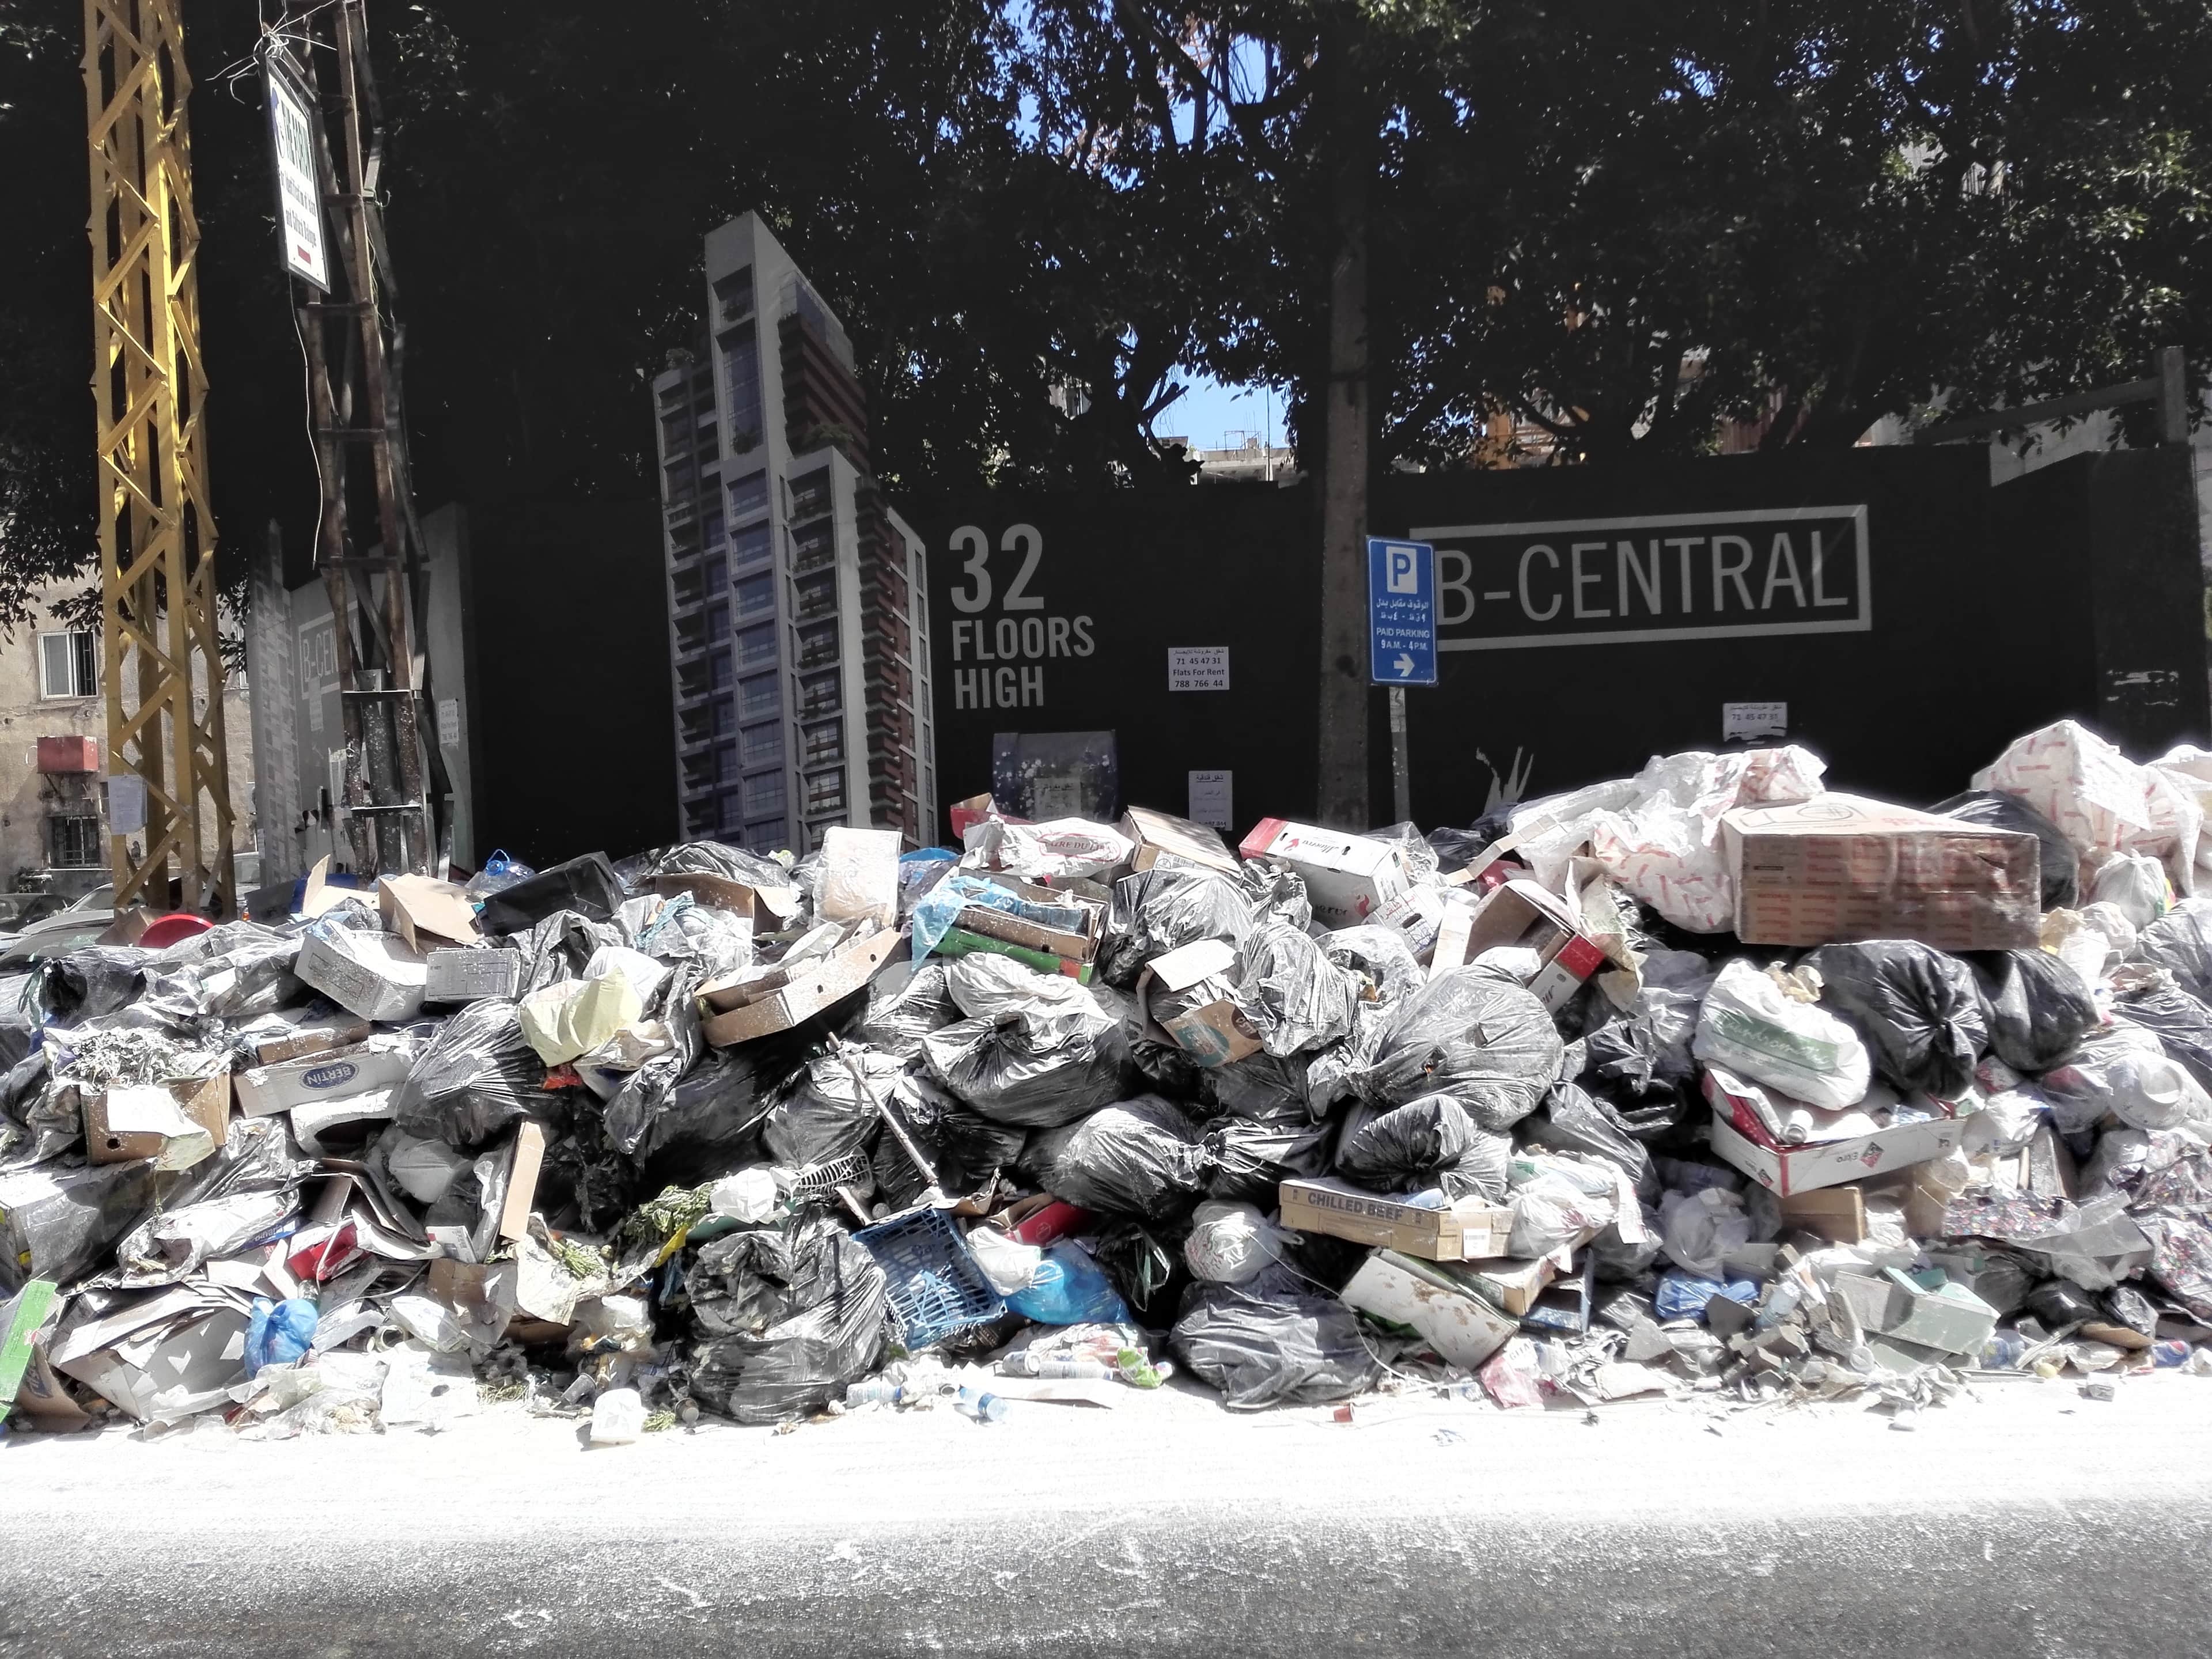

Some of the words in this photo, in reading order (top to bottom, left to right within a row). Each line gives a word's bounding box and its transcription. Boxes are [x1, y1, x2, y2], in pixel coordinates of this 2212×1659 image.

[949, 523, 1044, 612] 32
[1392, 553, 1410, 586] P
[1435, 531, 1848, 626] B-CENTRAL
[1407, 600, 1429, 611] الوقوف
[952, 615, 1096, 661] FLOORS
[1377, 627, 1393, 636] PAID
[1396, 628, 1430, 638] PARKING
[955, 665, 1044, 709] HIGH
[1308, 1192, 1363, 1214] CHILLED
[1368, 1203, 1404, 1221] BEEF
